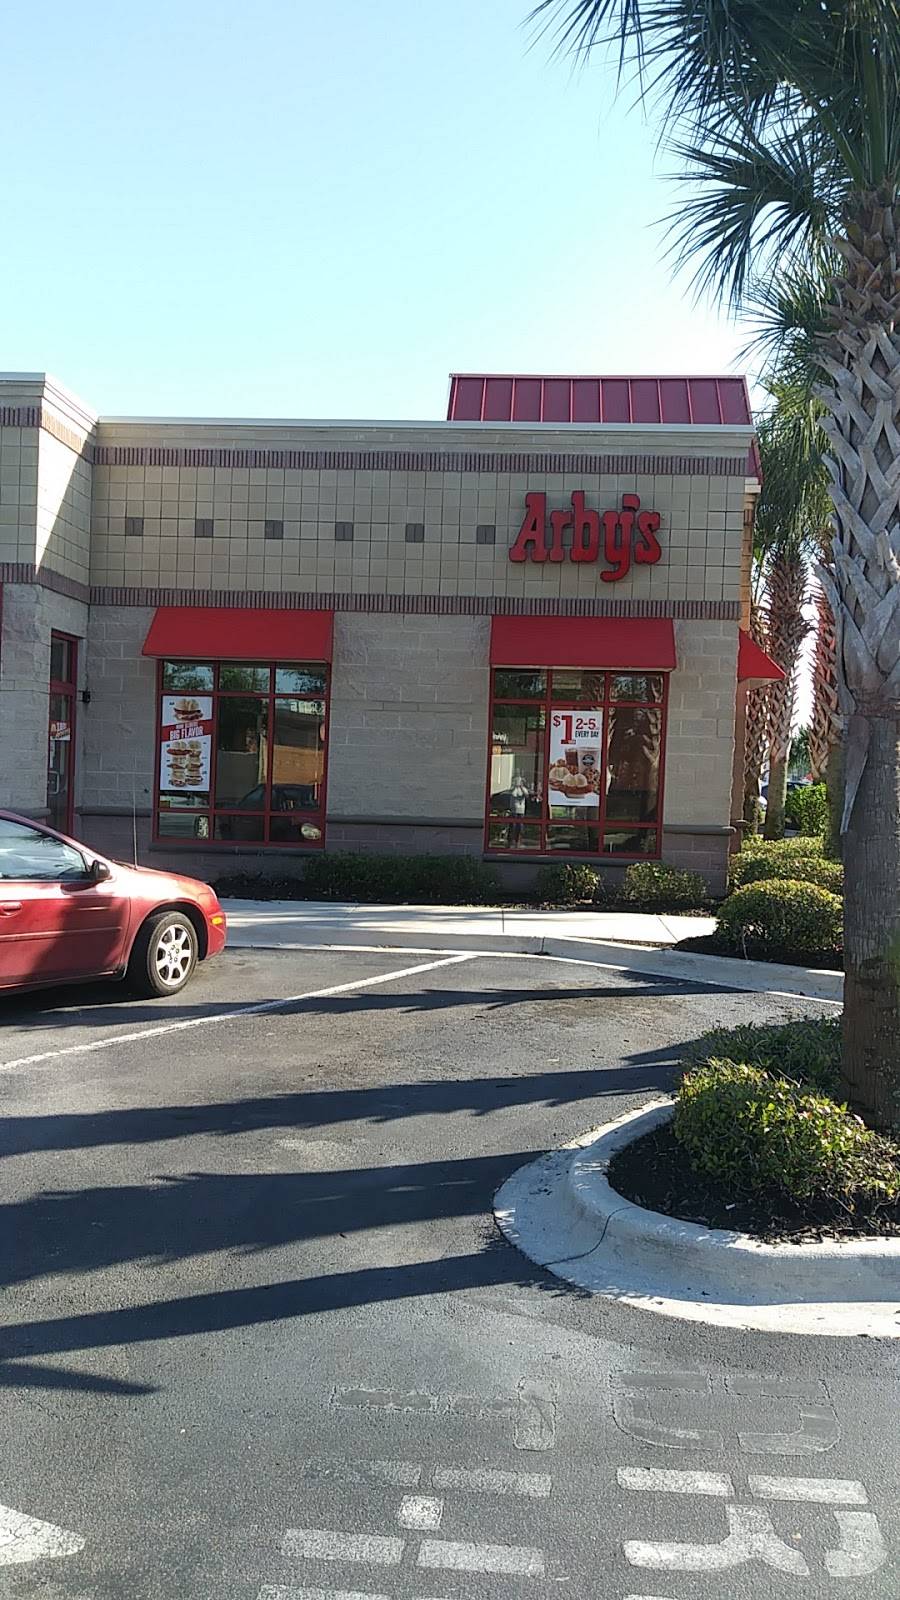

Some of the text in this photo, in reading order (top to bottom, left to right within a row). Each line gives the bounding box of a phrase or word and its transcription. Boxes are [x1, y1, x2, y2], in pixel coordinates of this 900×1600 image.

[509, 490, 662, 582] Arby's
[553, 715, 576, 744] $1
[576, 718, 596, 730] 2-5
[169, 727, 204, 741] BIG FLAVOR
[575, 730, 599, 738] EVERY DAY
